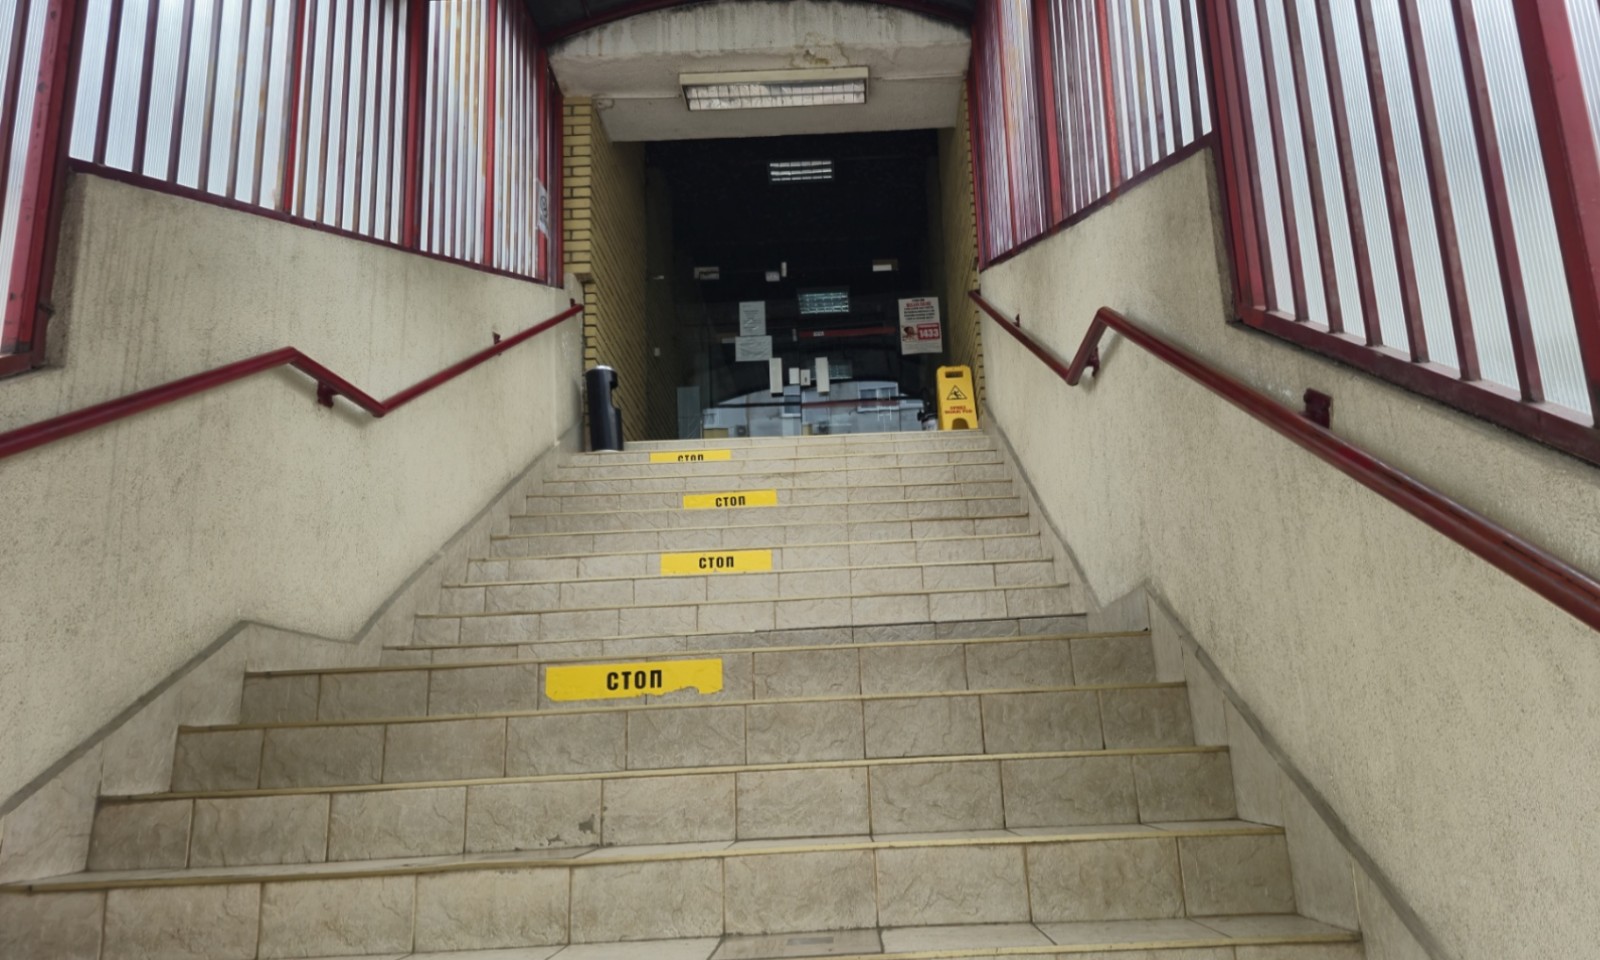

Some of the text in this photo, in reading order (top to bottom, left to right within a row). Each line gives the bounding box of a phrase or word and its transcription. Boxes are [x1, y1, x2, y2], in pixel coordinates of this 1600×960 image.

[715, 496, 746, 508] СТОП
[698, 556, 734, 569] СТОП
[606, 669, 663, 691] СТОП
